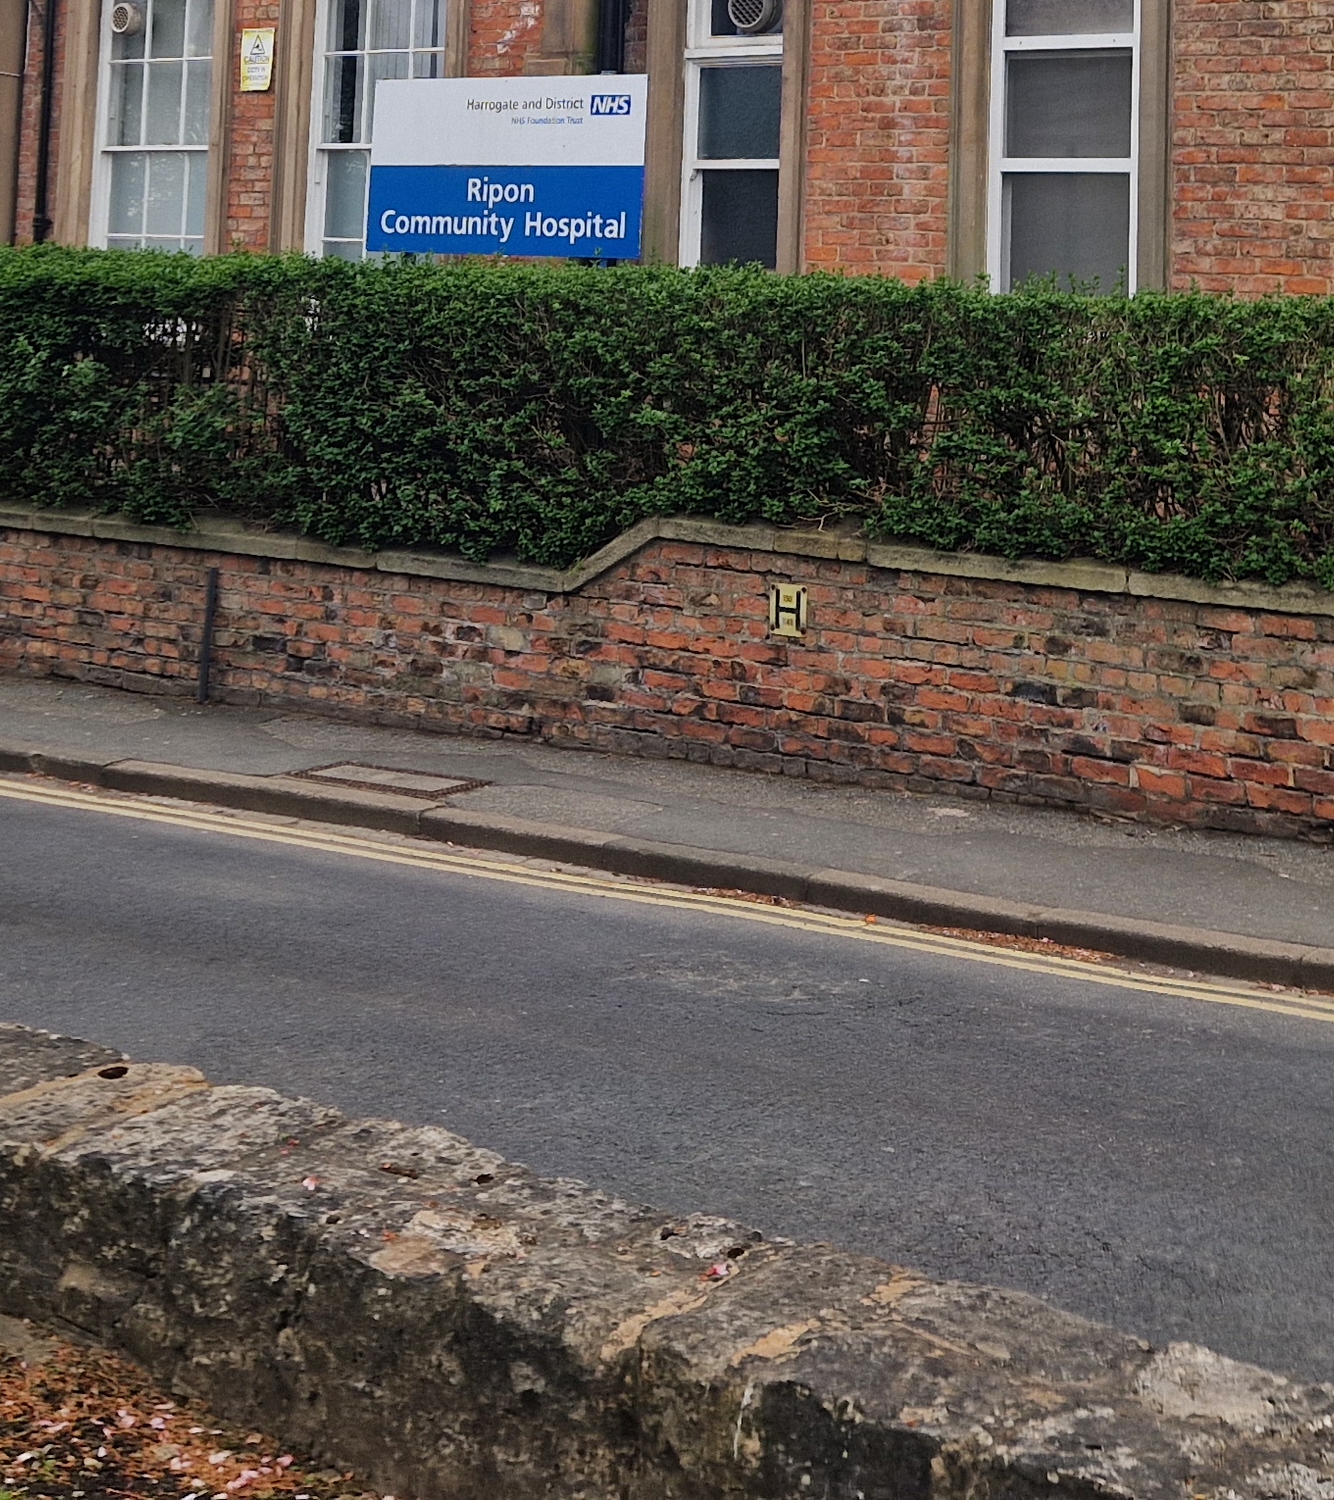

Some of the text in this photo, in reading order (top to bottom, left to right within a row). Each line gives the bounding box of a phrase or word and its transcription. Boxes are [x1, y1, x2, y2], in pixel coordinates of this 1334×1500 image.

[467, 96, 630, 114] Harrogate and District NHS
[511, 116, 584, 125] NHS Foundation Trust
[467, 176, 535, 208] Ripon
[380, 210, 626, 244] Community Hospital
[775, 589, 801, 631] H
